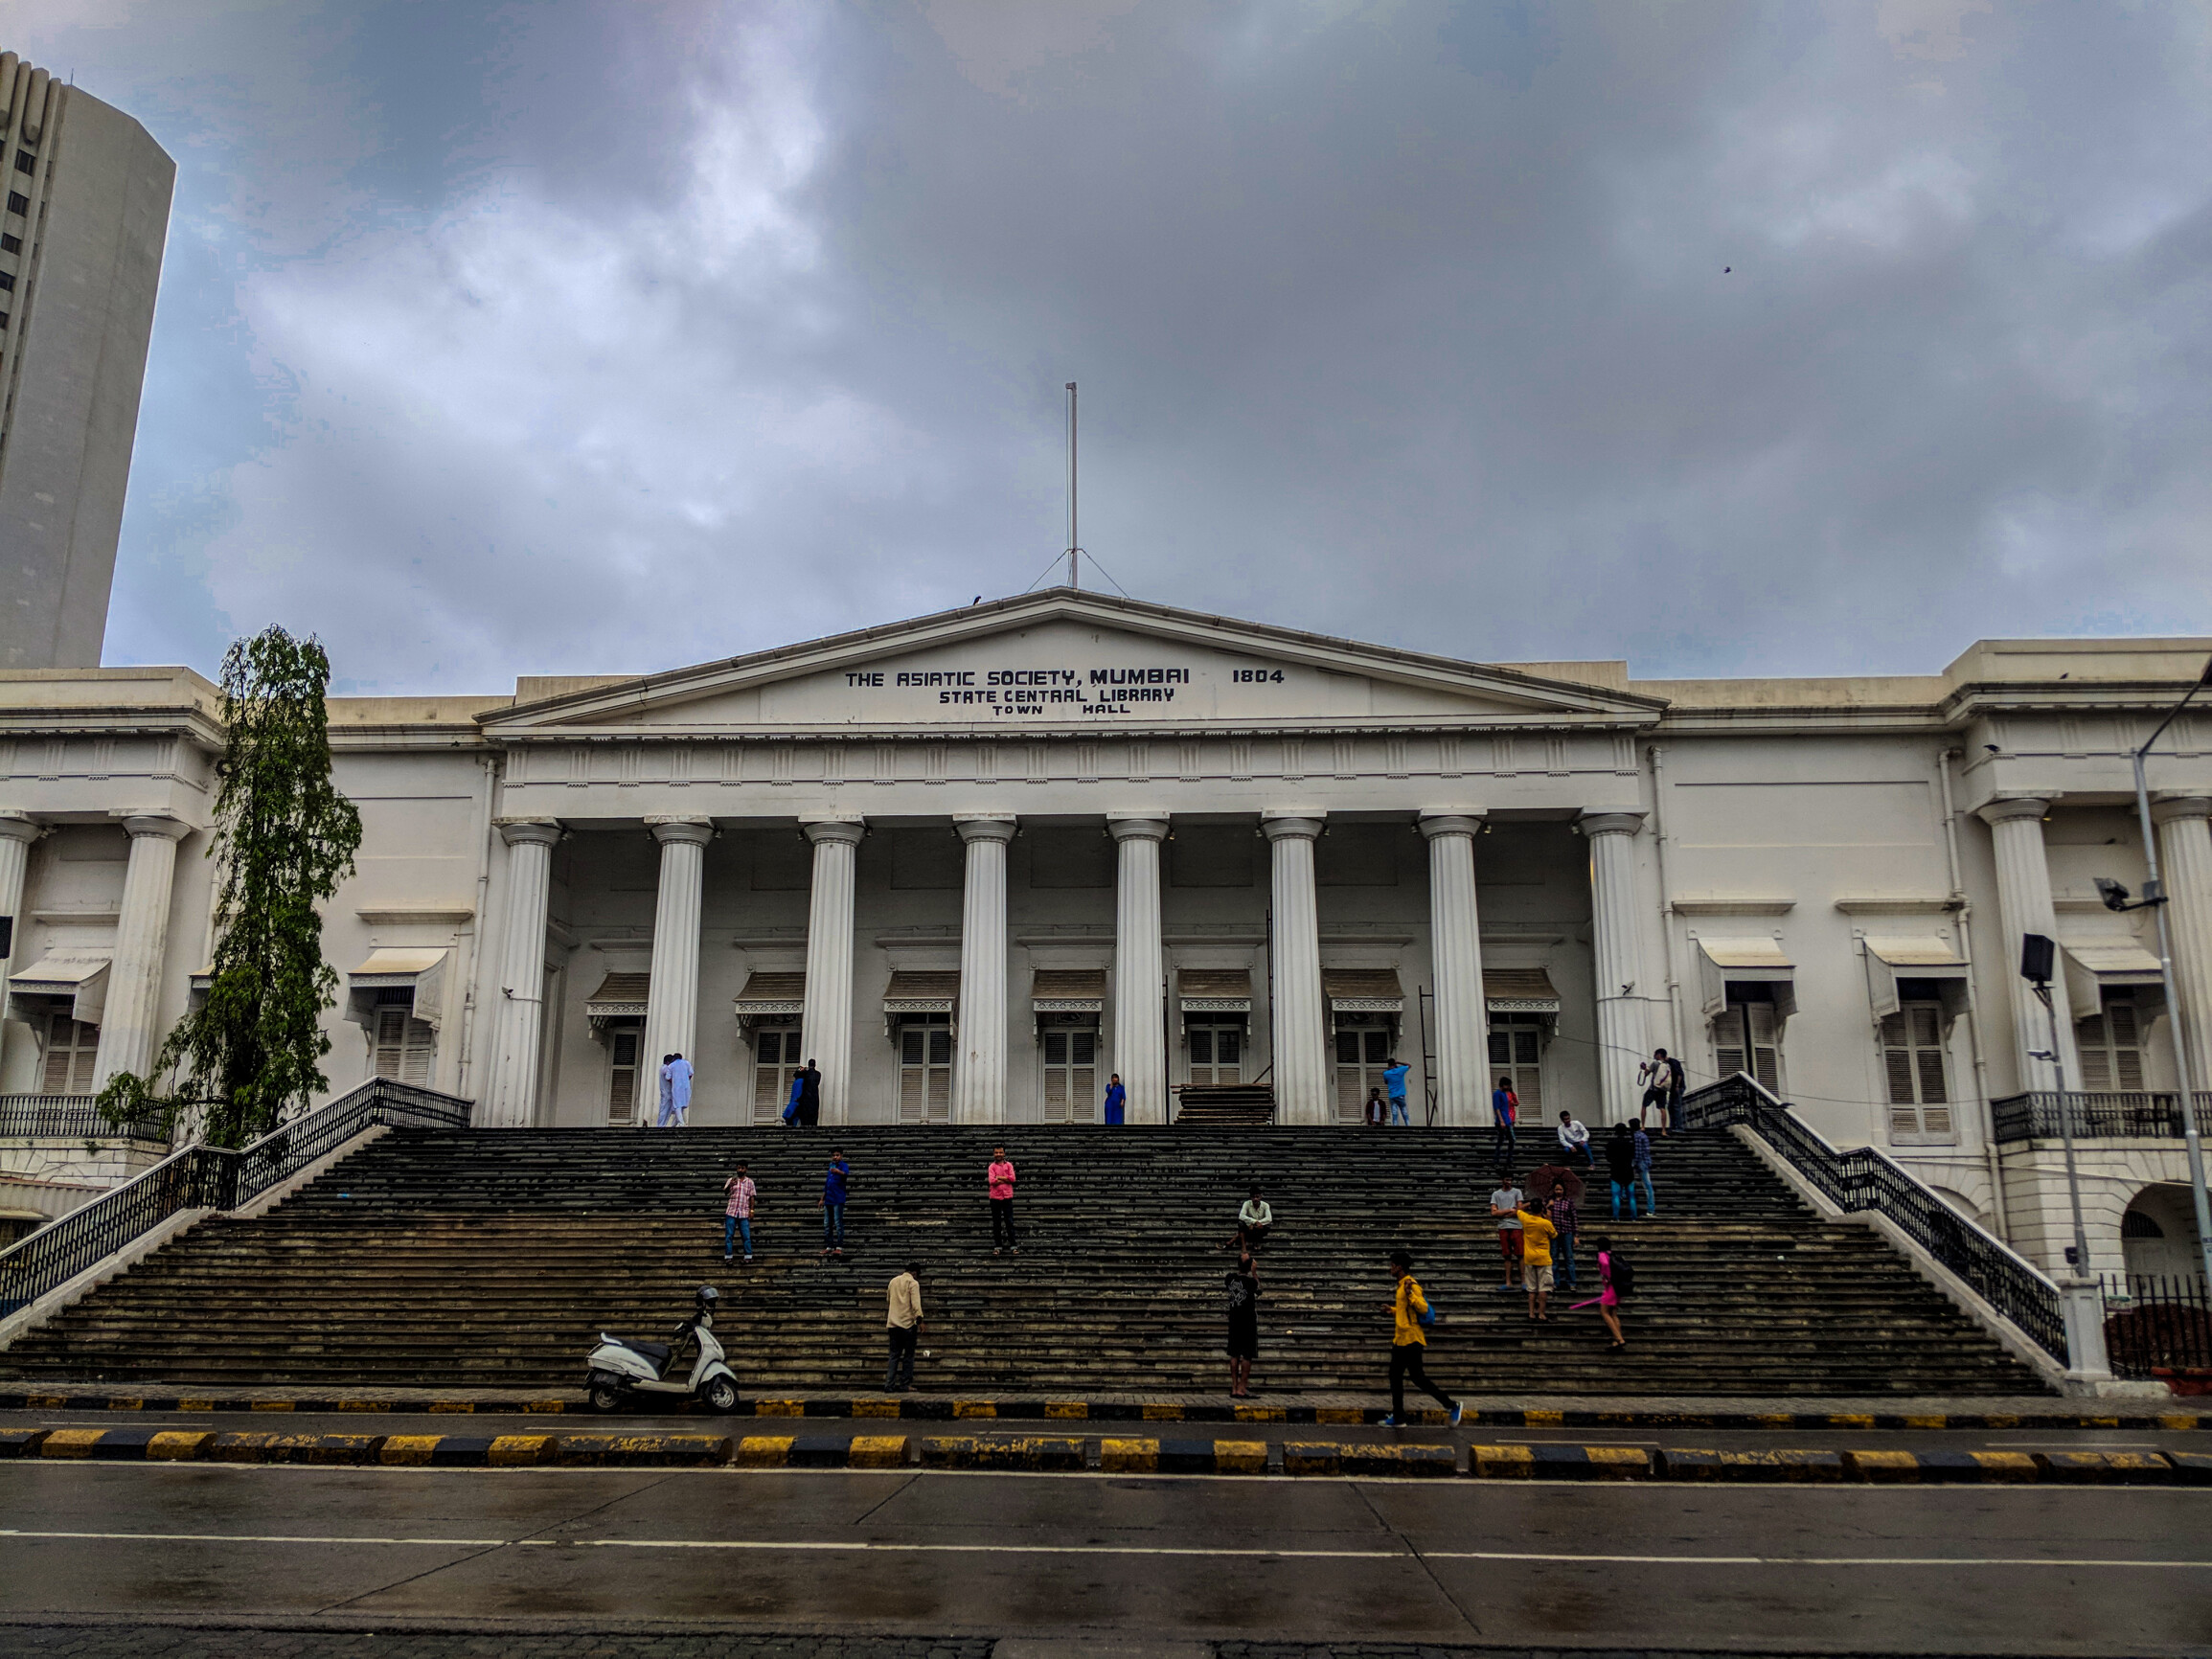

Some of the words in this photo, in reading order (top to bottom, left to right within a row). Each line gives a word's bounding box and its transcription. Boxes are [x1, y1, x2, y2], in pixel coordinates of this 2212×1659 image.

[845, 673, 884, 687] THE
[897, 671, 975, 687] ASIATIC
[1090, 669, 1190, 685] MUMBAI
[1232, 670, 1285, 684] 1804
[940, 690, 997, 704] STATE
[1003, 690, 1088, 704] CENTRAL
[1099, 688, 1174, 703] LIBRARY
[992, 705, 1043, 716] TOWN
[1083, 704, 1131, 715] HALL
